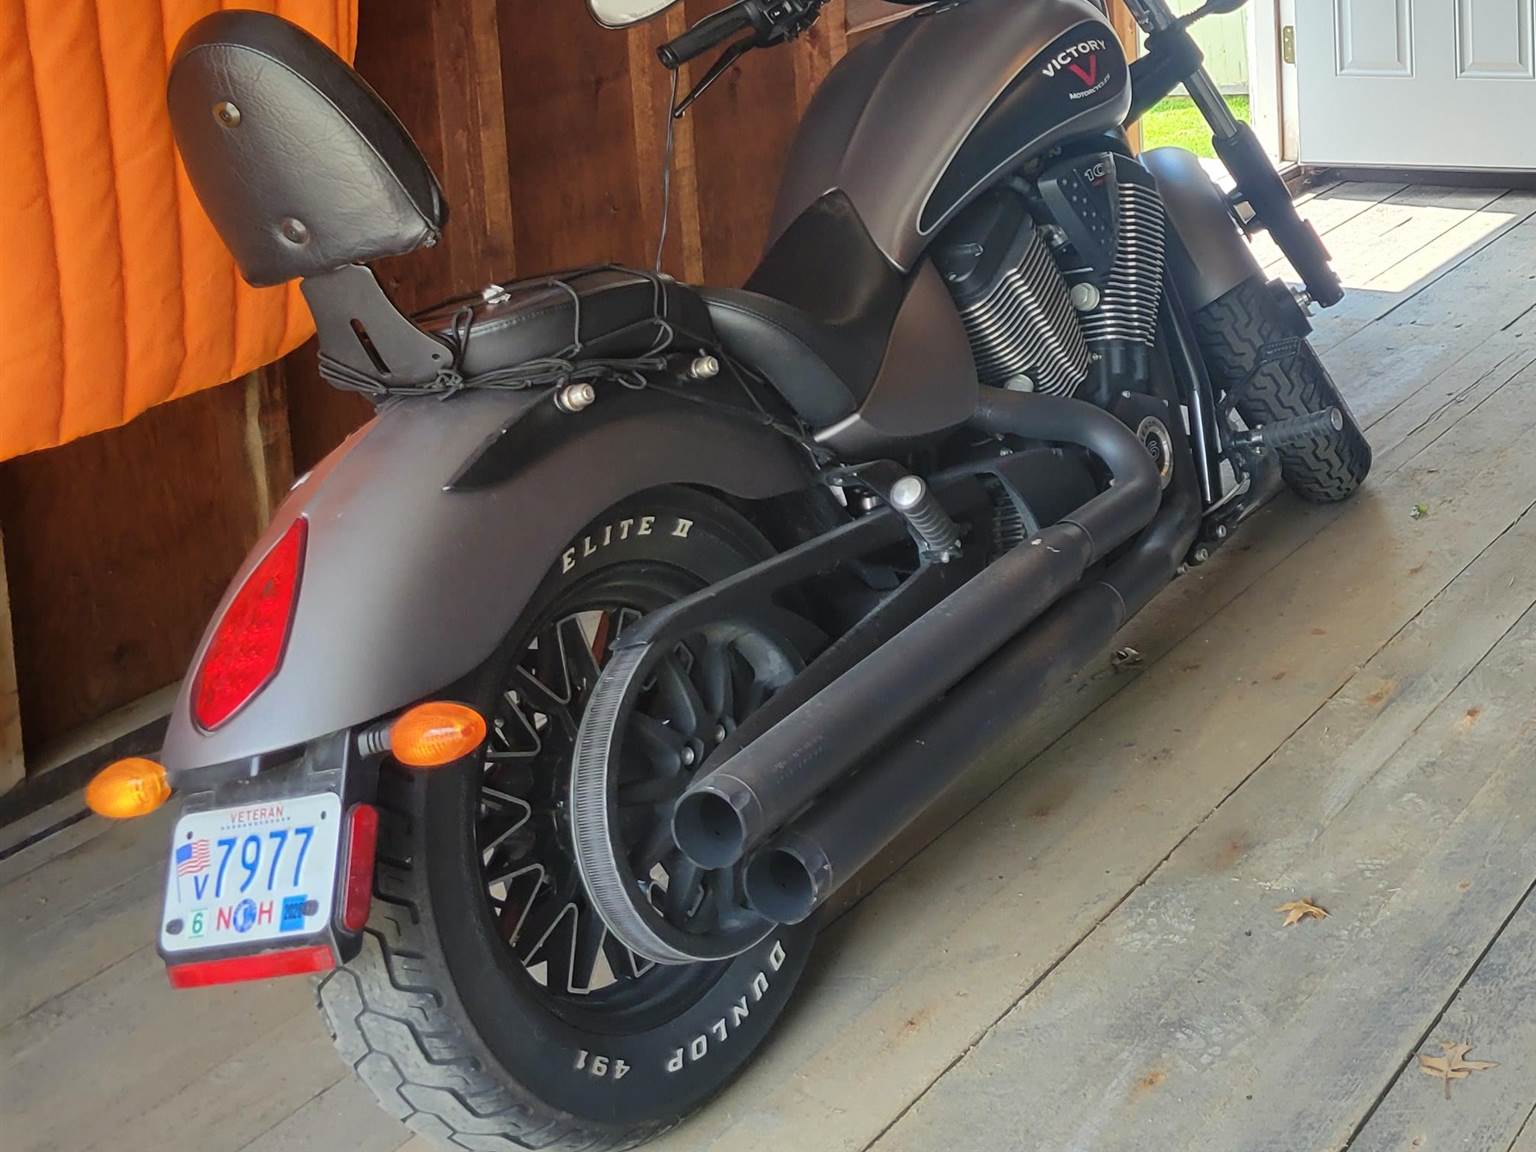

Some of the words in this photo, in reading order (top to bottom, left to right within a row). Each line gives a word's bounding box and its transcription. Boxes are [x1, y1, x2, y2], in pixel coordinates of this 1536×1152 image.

[1042, 39, 1106, 77] VICTORY
[562, 516, 655, 575] ELITE
[230, 805, 285, 823] VETERAN
[215, 825, 314, 898] 7977
[191, 912, 203, 934] 6
[667, 939, 786, 1072] DUNLOP
[574, 1050, 630, 1080] 491
